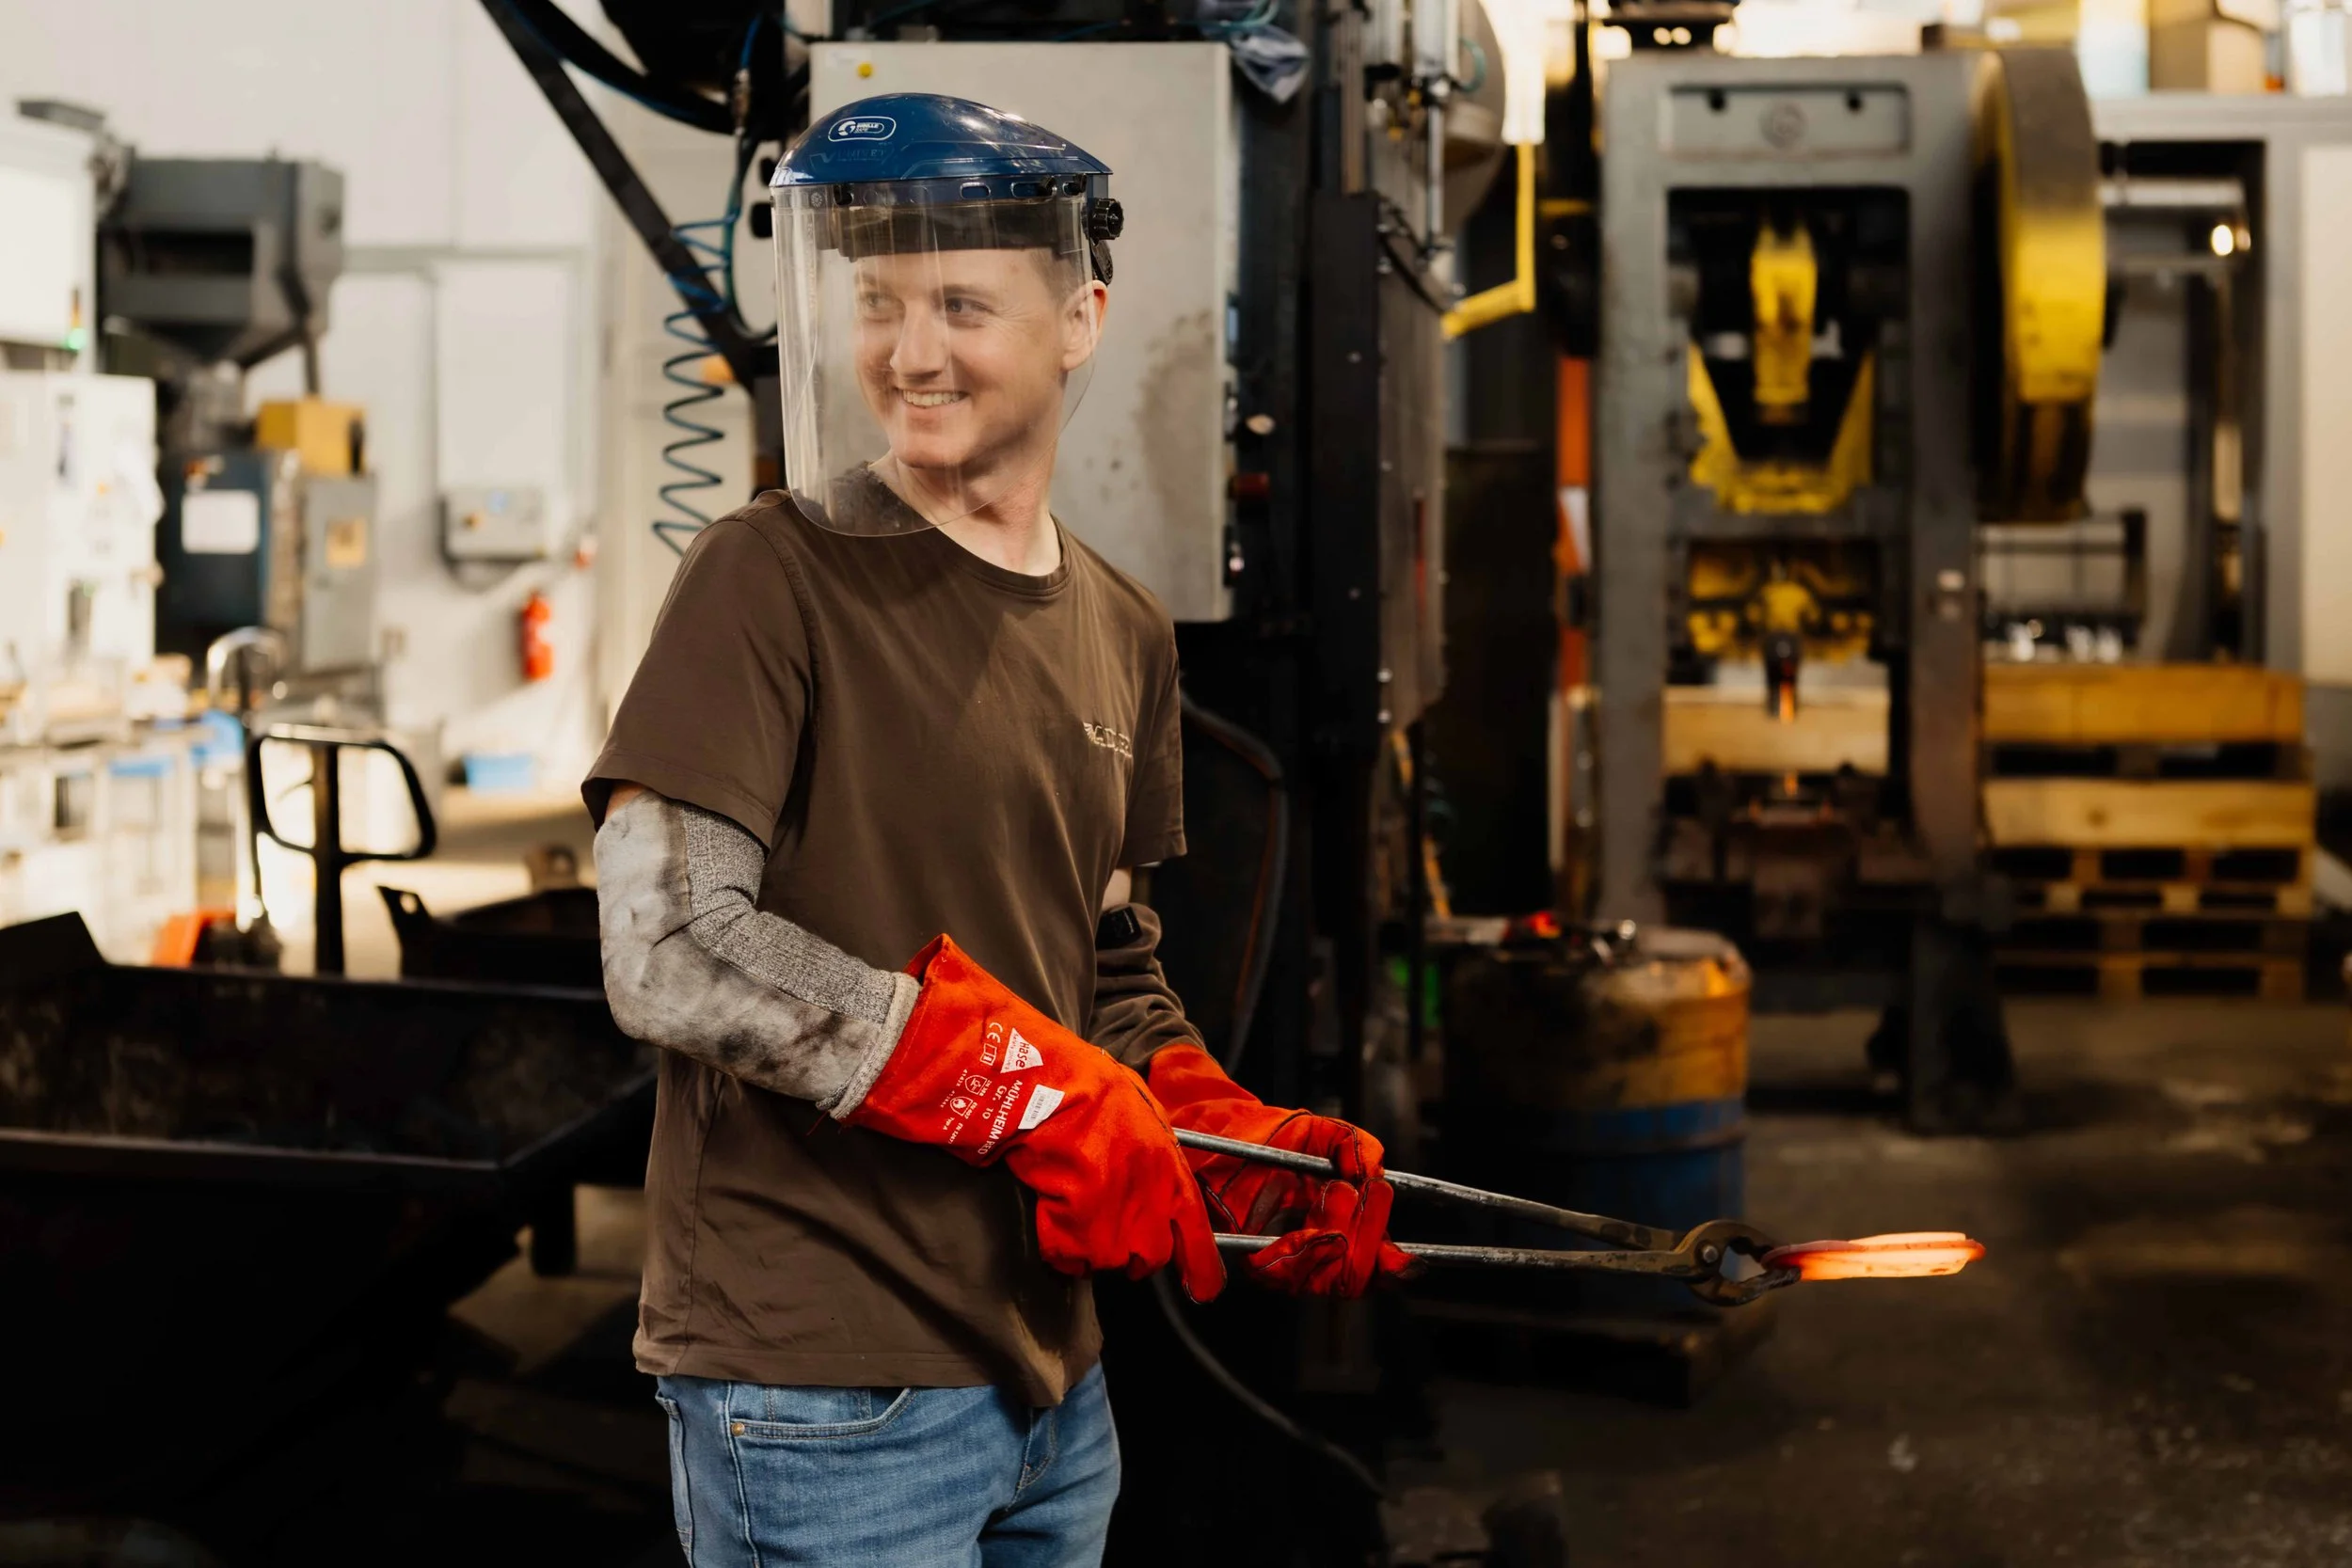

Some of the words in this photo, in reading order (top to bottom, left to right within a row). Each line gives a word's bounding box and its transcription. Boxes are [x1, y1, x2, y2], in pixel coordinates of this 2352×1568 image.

[987, 1022, 1003, 1043] CE
[1016, 1041, 1030, 1068] Hase
[992, 1085, 1008, 1101] Gr.
[982, 1107, 994, 1119] 10
[990, 1080, 1023, 1140] MÜHLHEIM
[977, 1139, 995, 1155] RED
